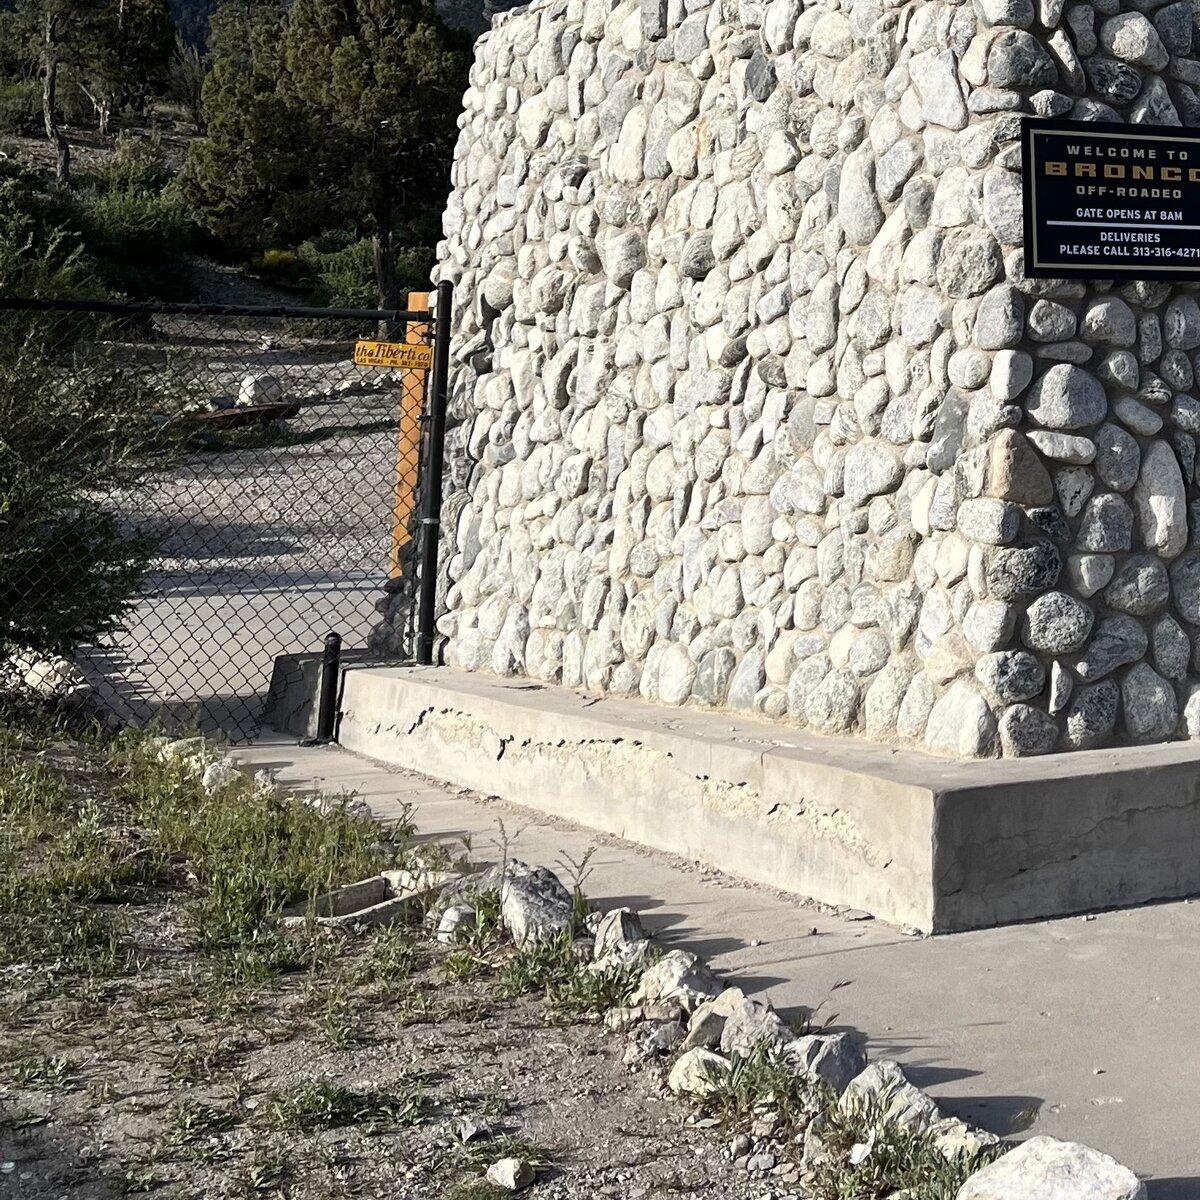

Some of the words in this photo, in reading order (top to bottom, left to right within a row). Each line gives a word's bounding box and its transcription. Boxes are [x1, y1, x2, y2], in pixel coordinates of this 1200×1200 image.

[1066, 145, 1157, 159] WELCOME
[1167, 151, 1189, 160] TO
[1076, 185, 1182, 199] OFF-ROADEO
[1076, 208, 1103, 218] GATE
[1106, 209, 1141, 219] OPENS
[1144, 211, 1157, 220] AT
[1160, 211, 1183, 221] 8AM
[1100, 232, 1161, 243] DELIVERIES
[1059, 245, 1100, 255] PLEASE
[1103, 246, 1130, 256] CALL
[1132, 247, 1200, 258] 313-316-4271
